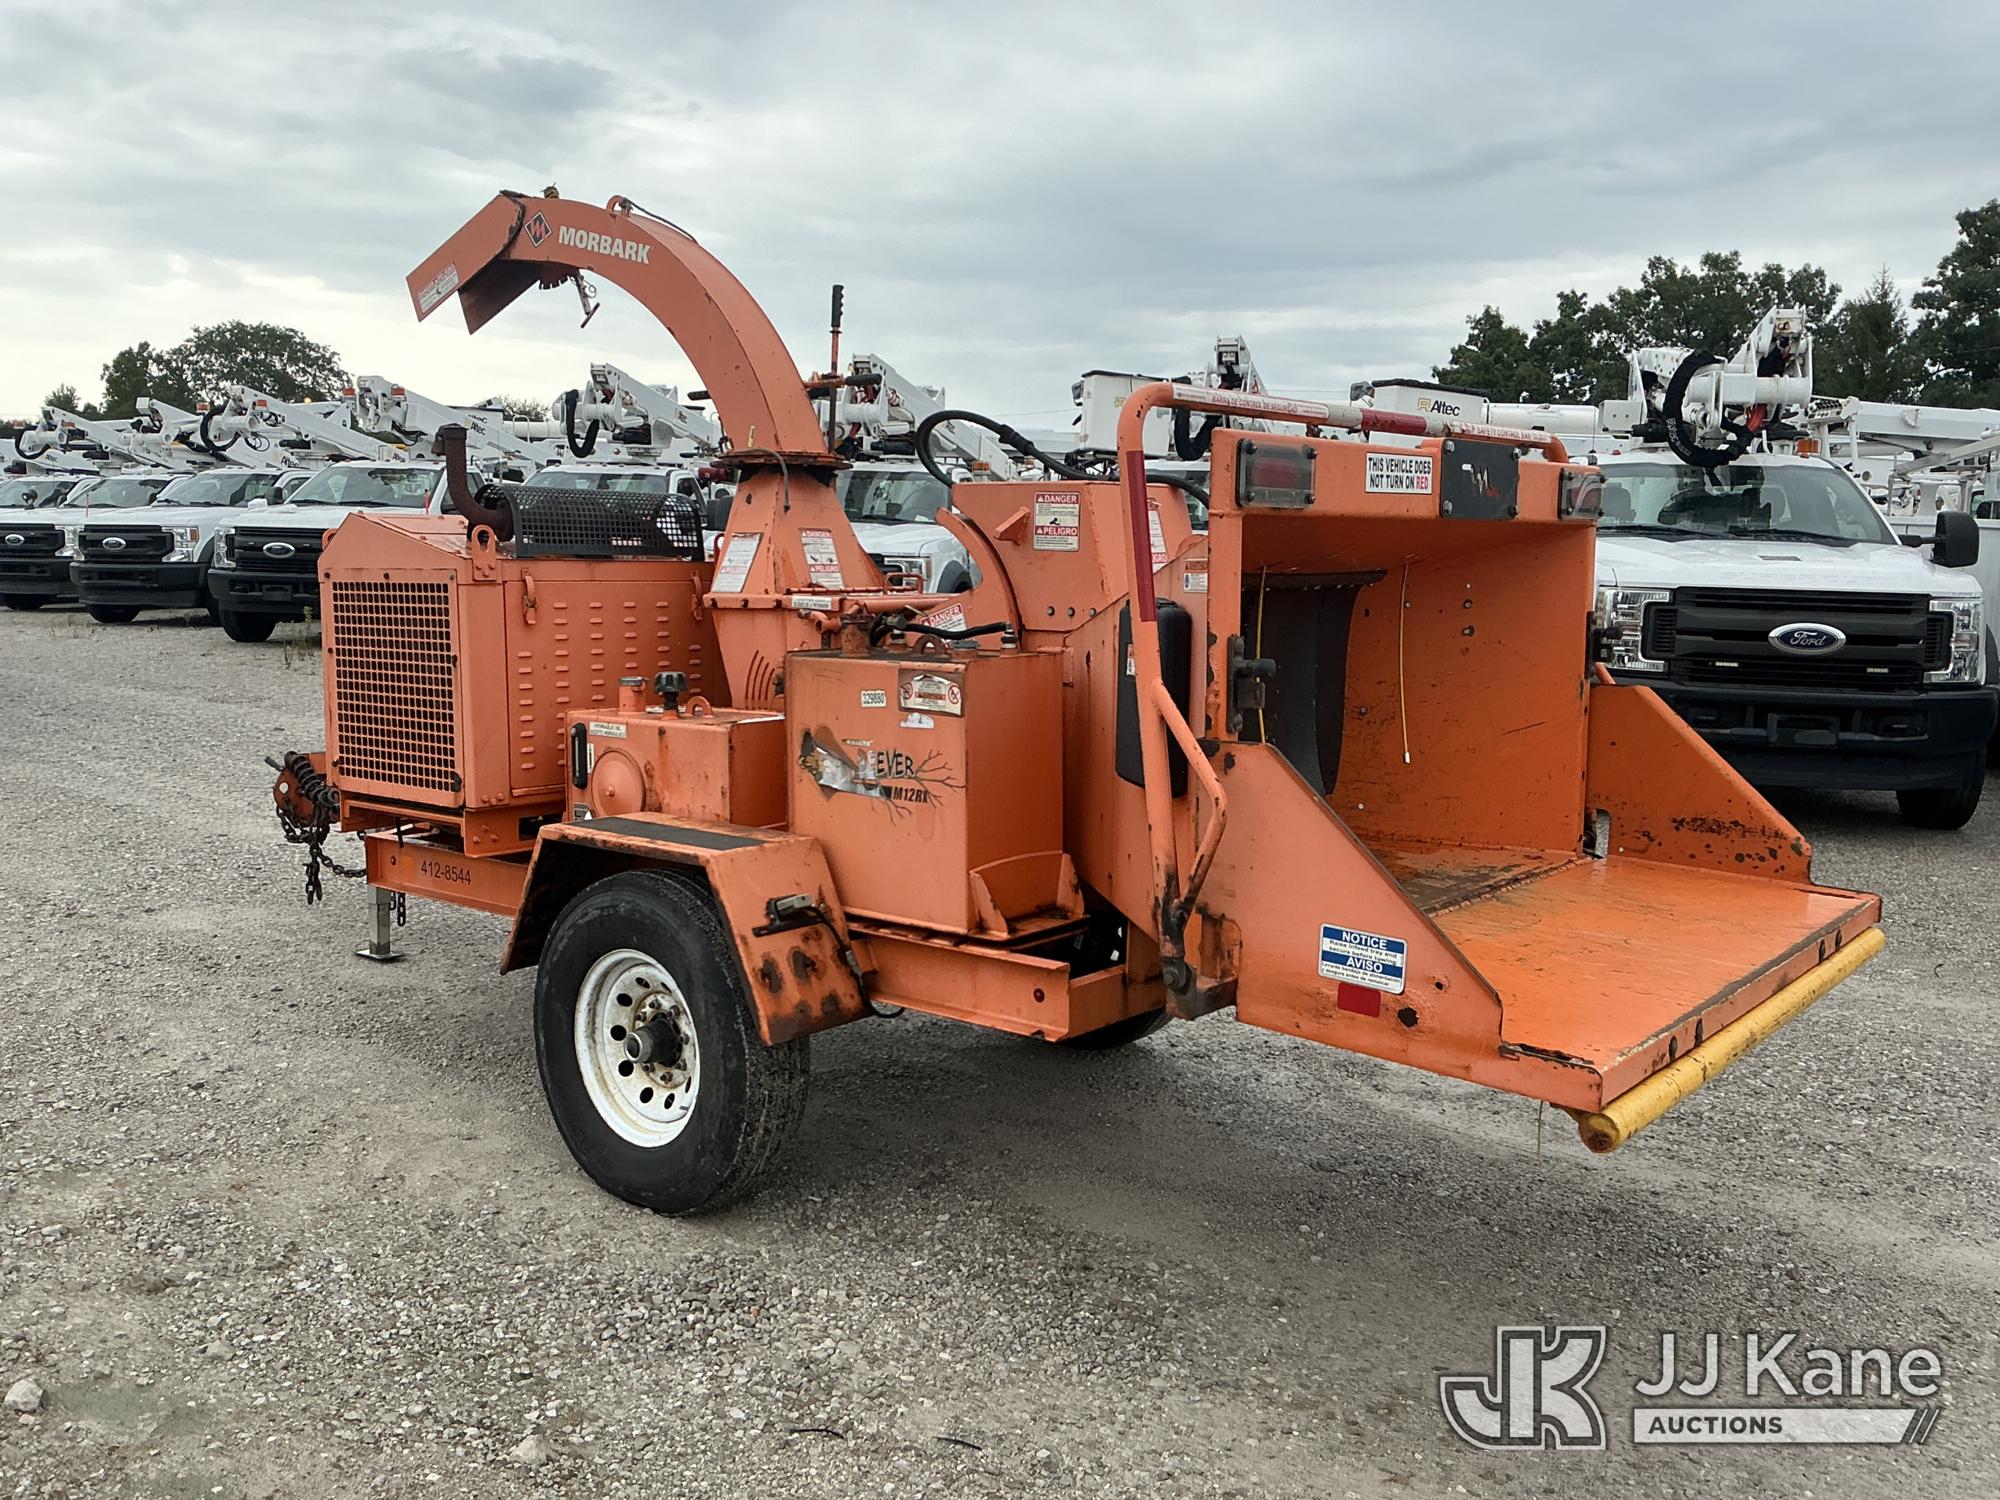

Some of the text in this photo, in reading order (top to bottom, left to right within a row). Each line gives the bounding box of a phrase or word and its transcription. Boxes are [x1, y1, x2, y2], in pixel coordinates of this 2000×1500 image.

[558, 225, 651, 265] MORBARK
[1430, 400, 1461, 416] Altec
[1368, 457, 1431, 474] THIS VEHICLE DOES
[1370, 474, 1429, 490] NOT TURN ON RED
[1044, 494, 1078, 503] DANGER
[1043, 527, 1078, 536] PELIGRO
[929, 606, 960, 626] DANGER
[1789, 630, 1827, 646] Ford
[421, 860, 472, 885] 412-8544
[1329, 939, 1398, 959] Raise infeed tray and
[1342, 931, 1388, 950] NOTICE
[1329, 946, 1351, 955] secure
[1352, 950, 1373, 960] before
[1346, 956, 1383, 973] AVISO
